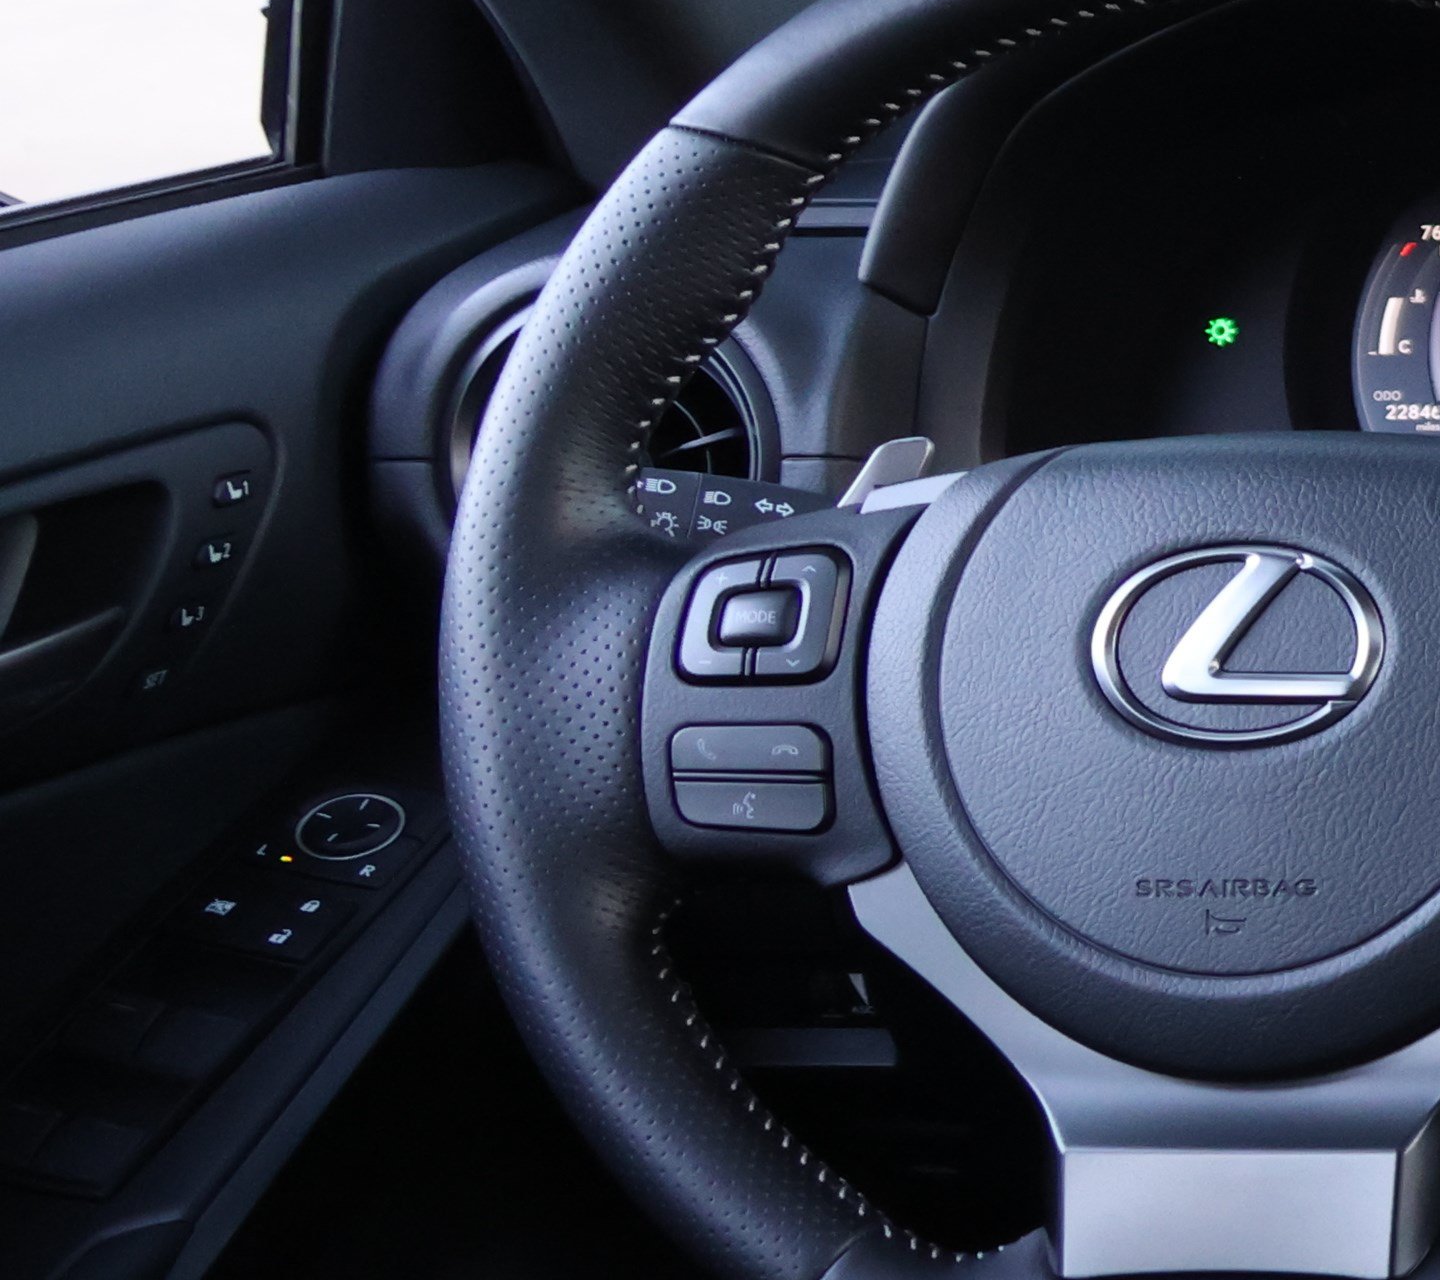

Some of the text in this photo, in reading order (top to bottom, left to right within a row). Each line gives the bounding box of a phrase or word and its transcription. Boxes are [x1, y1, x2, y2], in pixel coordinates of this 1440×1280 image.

[1398, 340, 1412, 354] C
[1373, 390, 1402, 402] ODO
[735, 610, 777, 625] MODE
[358, 864, 377, 878] R
